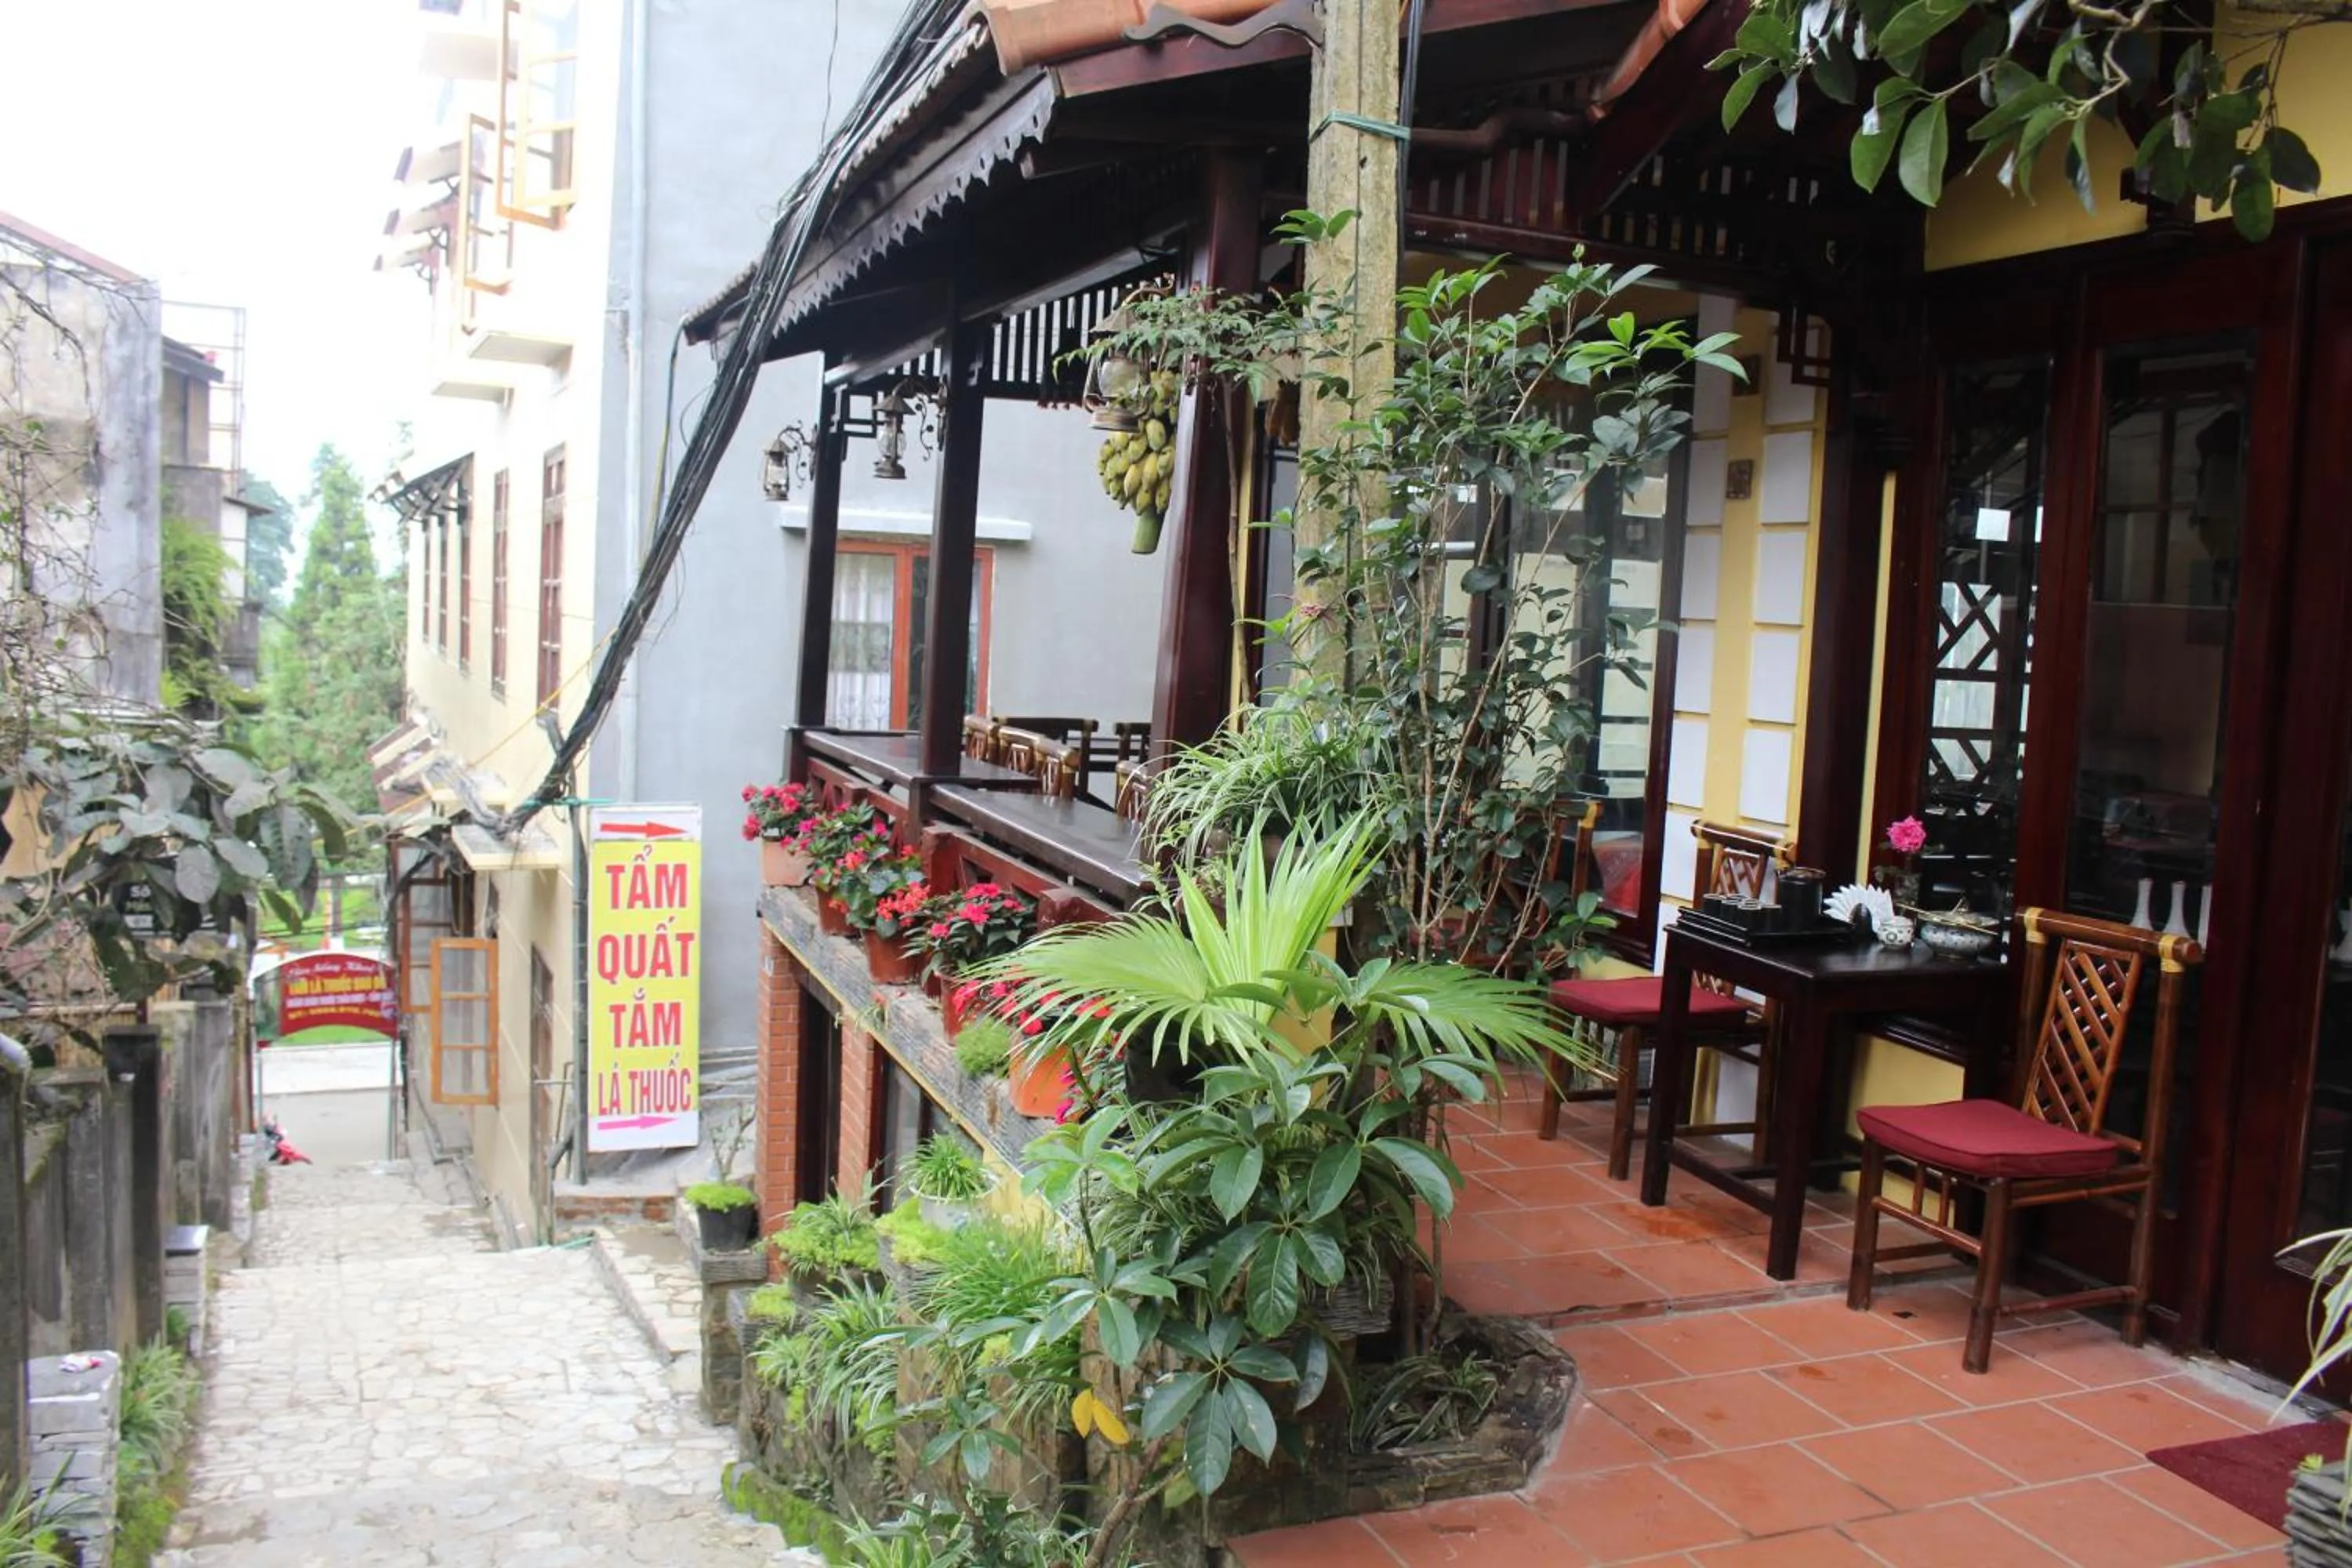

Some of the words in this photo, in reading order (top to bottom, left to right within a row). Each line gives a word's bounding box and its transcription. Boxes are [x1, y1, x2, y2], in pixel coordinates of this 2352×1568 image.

[605, 844, 687, 909] TẨM
[597, 915, 695, 985] QUẤT
[609, 987, 681, 1048] TẮM
[598, 1062, 621, 1116] LÁ
[628, 1051, 691, 1114] THUỐC
